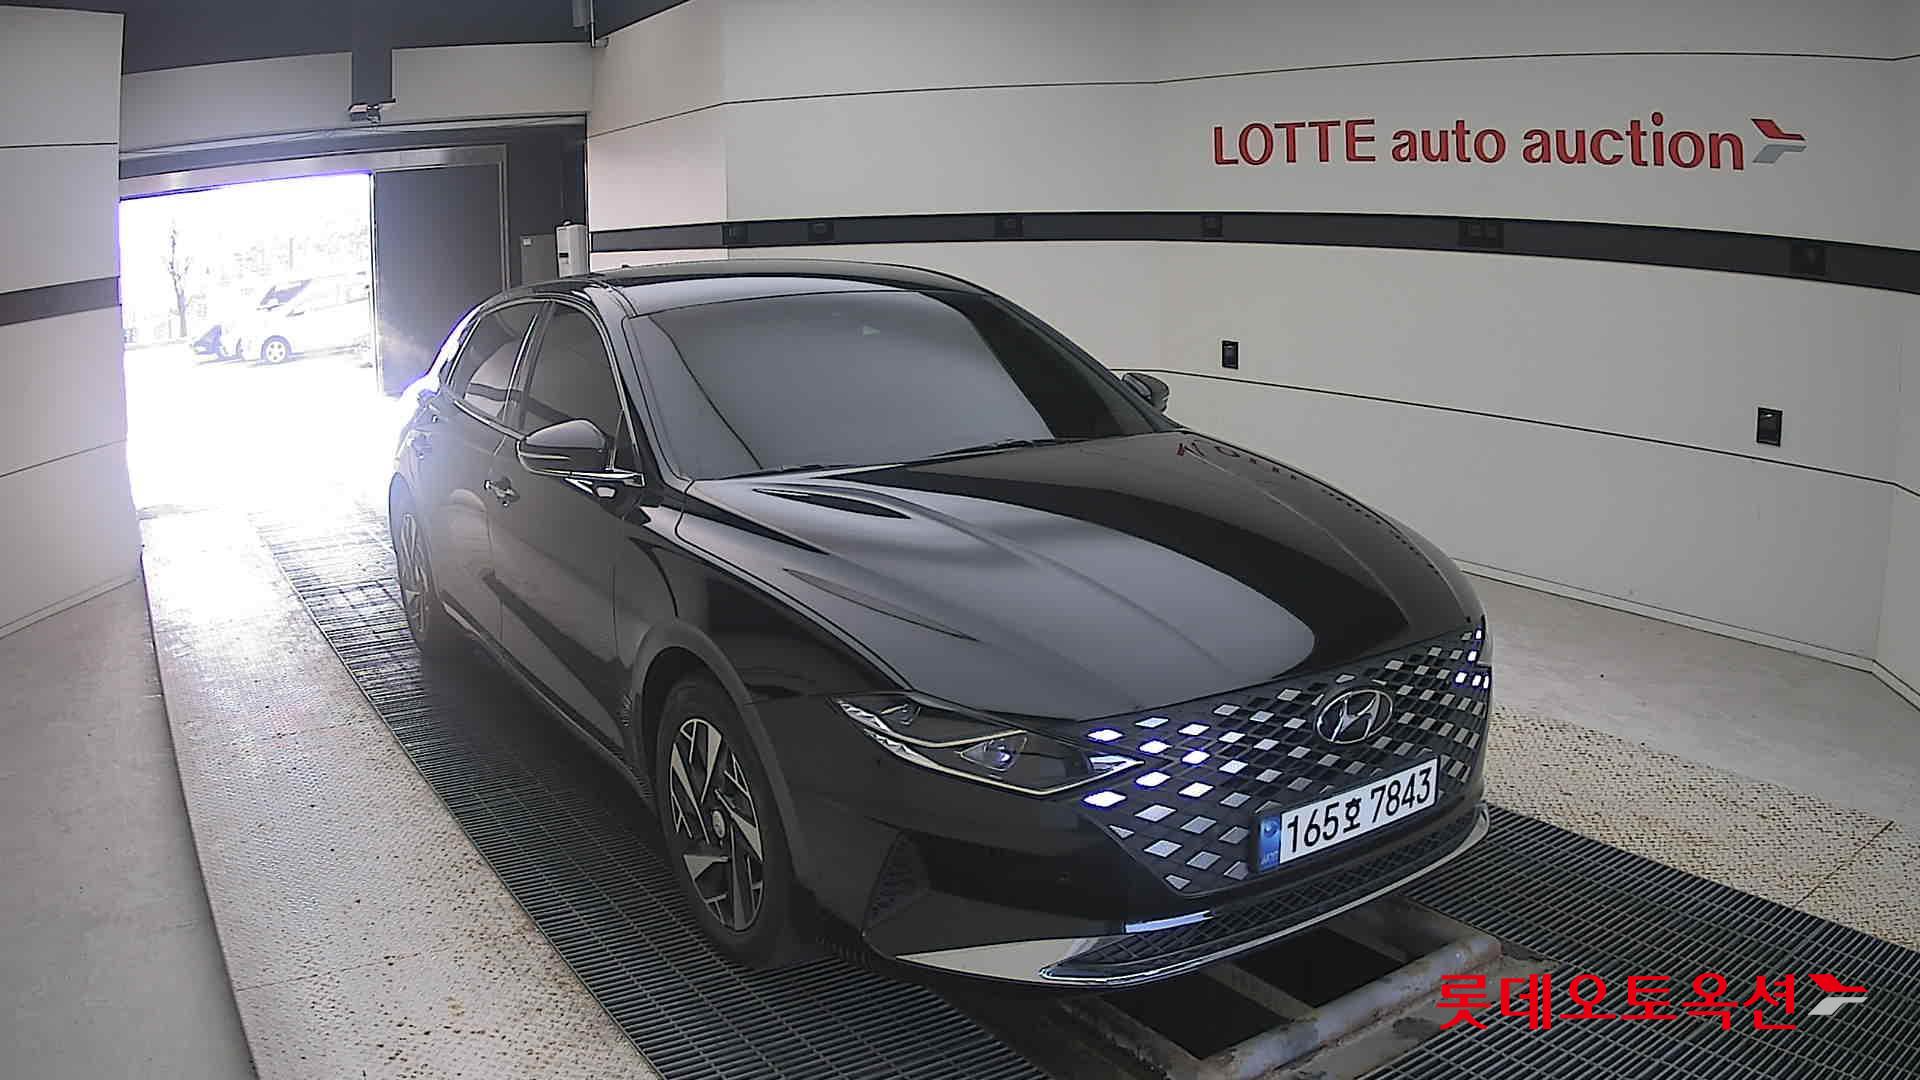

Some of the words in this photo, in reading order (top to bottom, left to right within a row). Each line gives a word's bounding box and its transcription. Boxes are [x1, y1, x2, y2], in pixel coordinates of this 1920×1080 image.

[1213, 119, 1377, 166] LOTTE
[1391, 119, 1506, 164] auto
[1522, 112, 1745, 170] auction
[1287, 797, 1362, 853] 165호
[1370, 766, 1433, 824] 7843
